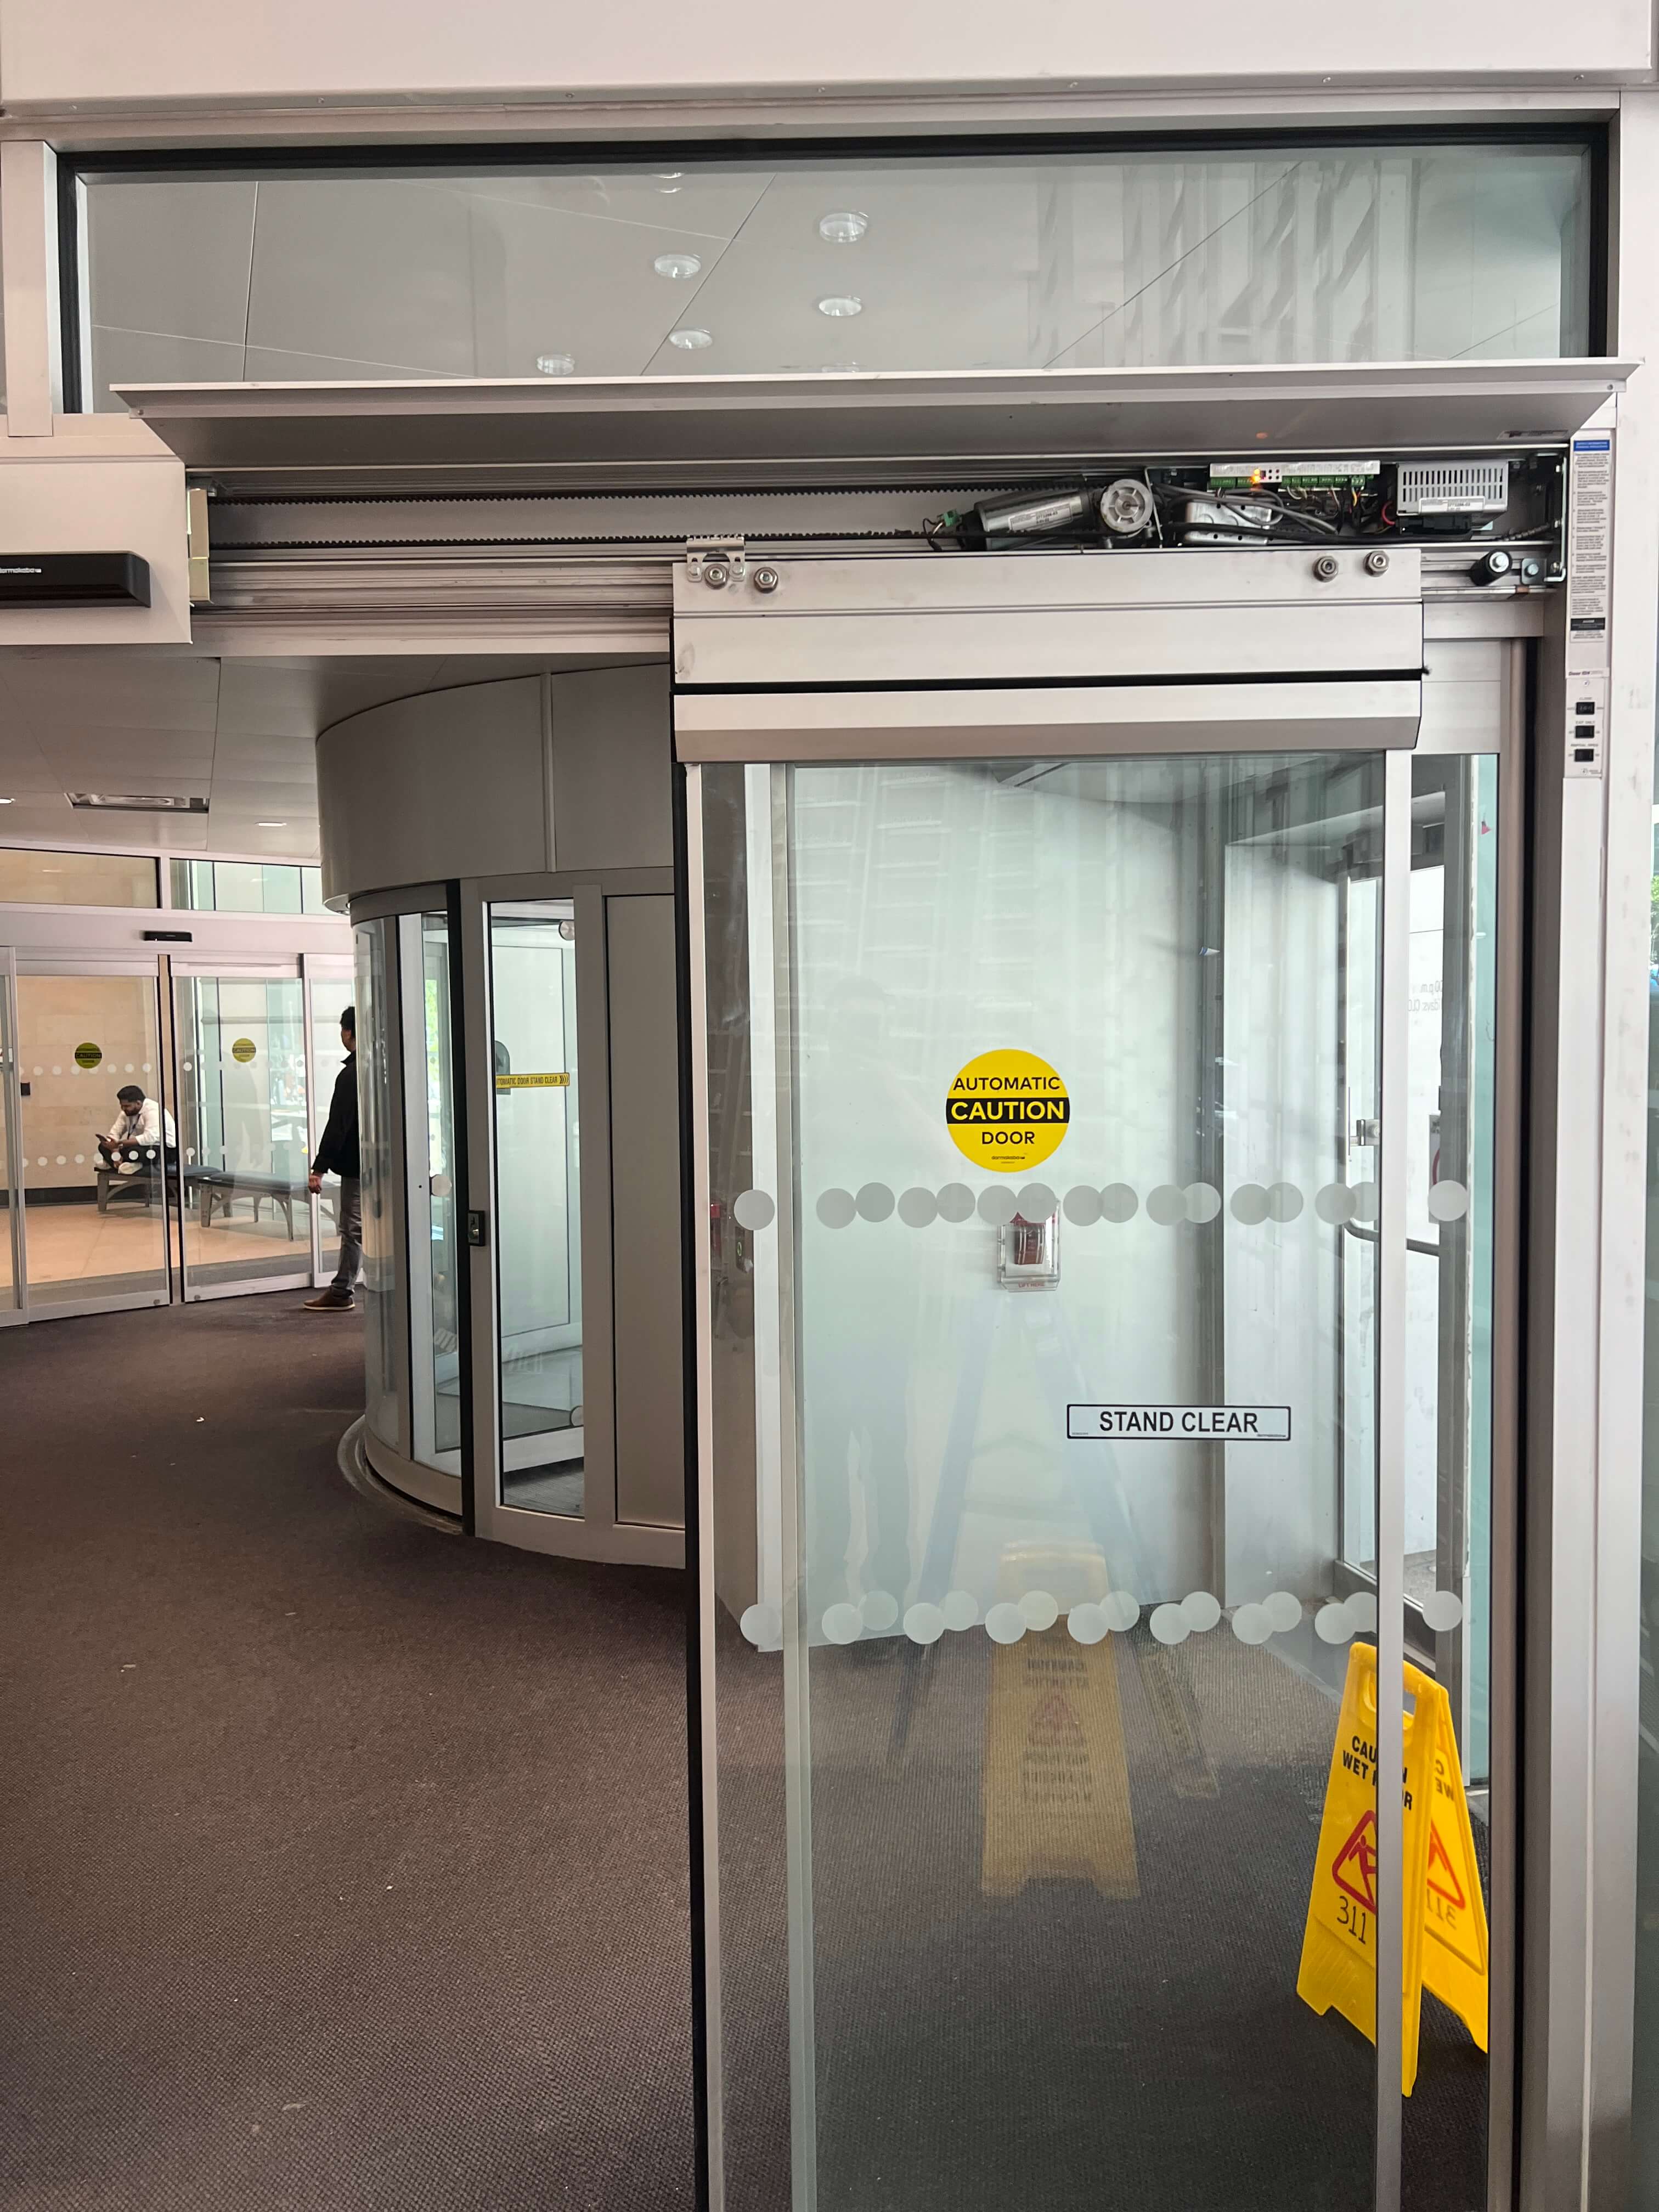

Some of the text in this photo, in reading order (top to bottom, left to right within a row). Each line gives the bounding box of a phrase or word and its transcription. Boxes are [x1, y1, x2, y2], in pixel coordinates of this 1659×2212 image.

[953, 1076, 1060, 1091] AUTOMATIC
[951, 1101, 1064, 1120] CAUTION
[981, 1131, 1035, 1144] DOOR
[1099, 1411, 1258, 1433] STAND CLEAR
[1343, 1750, 1369, 1780] WET
[1337, 1896, 1366, 1944] 311
